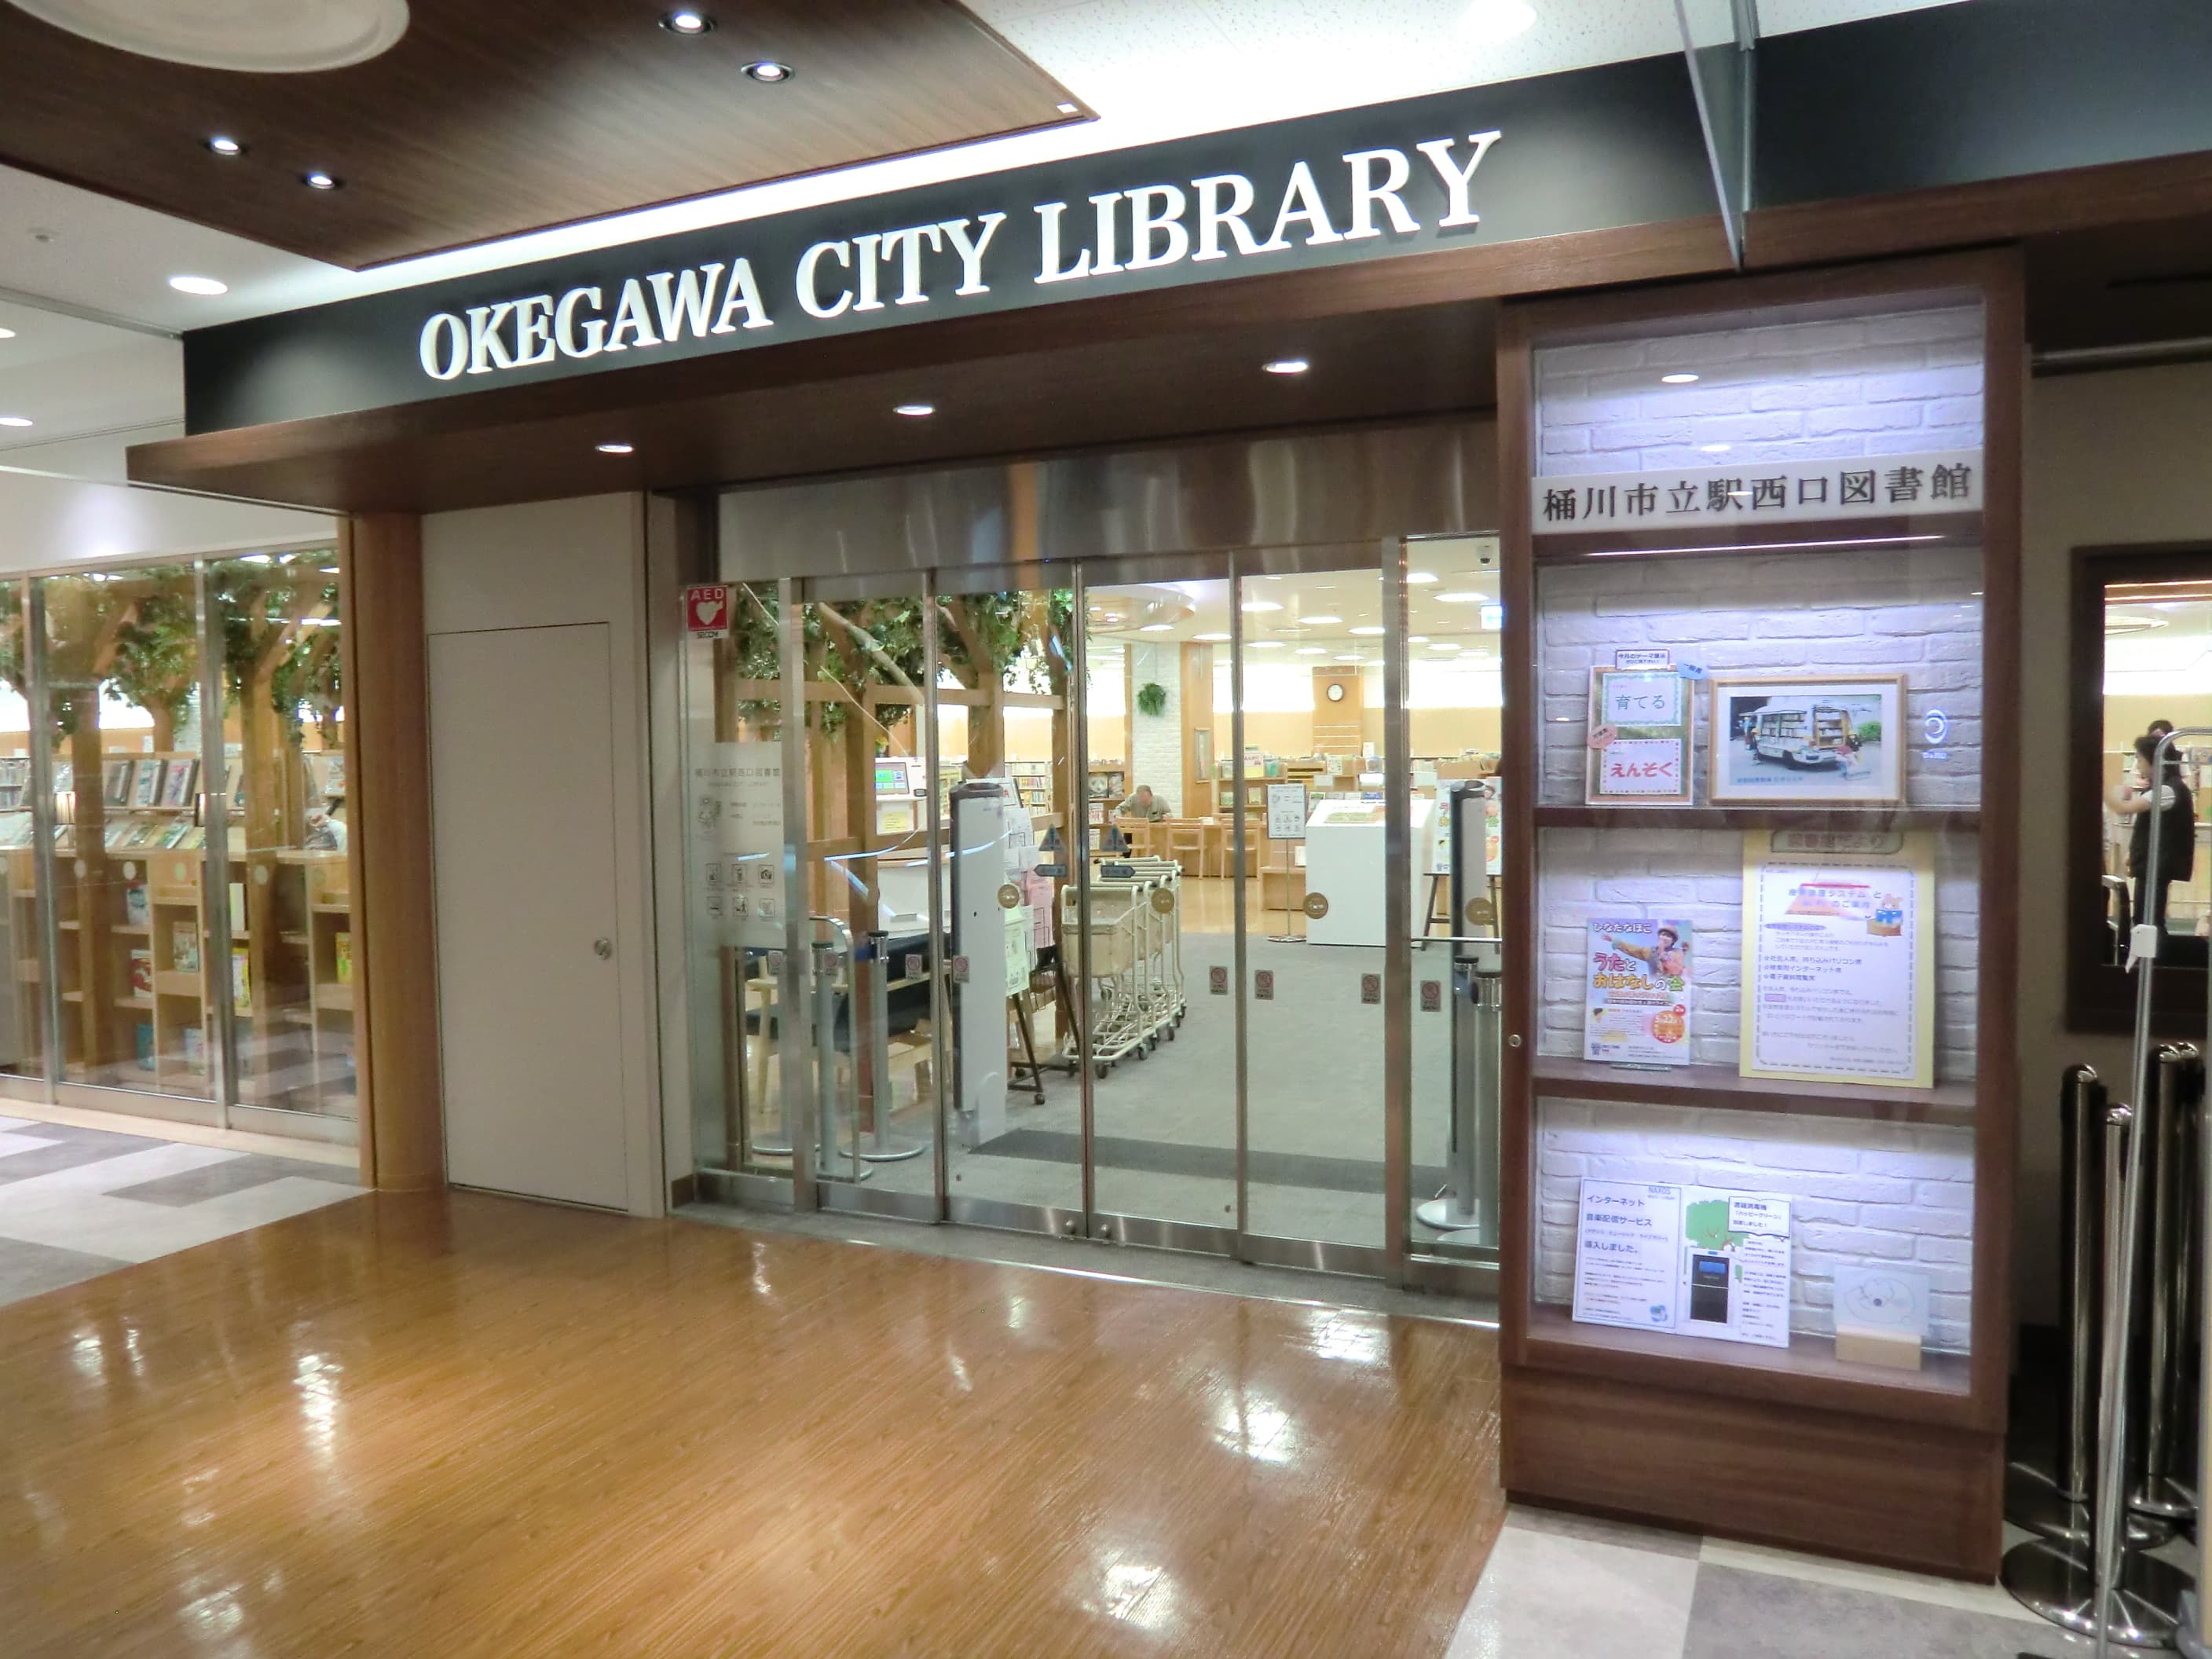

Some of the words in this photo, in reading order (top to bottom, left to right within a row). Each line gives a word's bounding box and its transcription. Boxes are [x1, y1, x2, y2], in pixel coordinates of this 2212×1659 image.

[419, 258, 775, 380] OKEGAWA
[795, 211, 1006, 318] CITY
[1033, 130, 1502, 285] LIBRARY
[1541, 463, 1972, 522] 桶川市立駅西口図書館
[690, 588, 724, 600] AED
[1615, 694, 1666, 711] 育てる
[1610, 761, 1674, 778] えんそく
[1594, 952, 1636, 972] うたと
[1593, 972, 1685, 992] おはなしの会
[1587, 1195, 1646, 1207] インターネット
